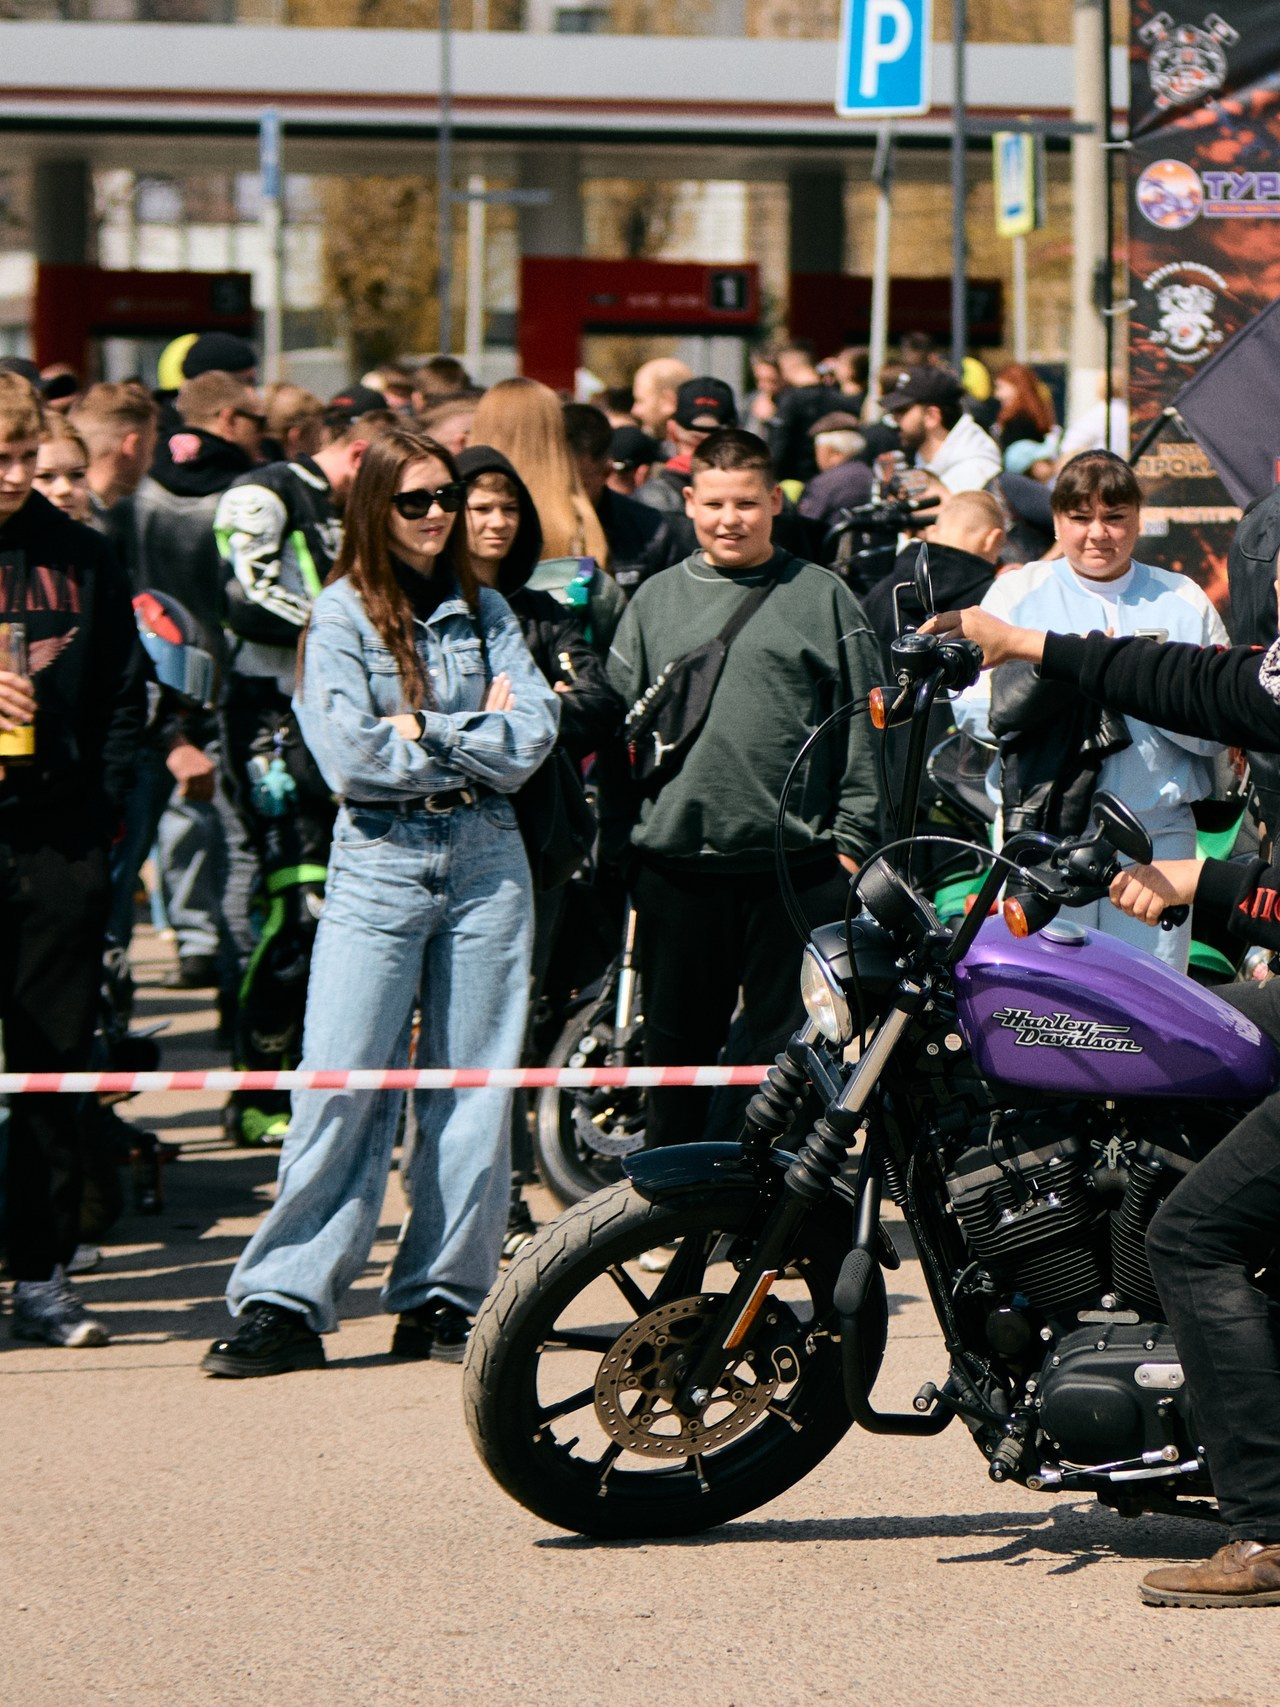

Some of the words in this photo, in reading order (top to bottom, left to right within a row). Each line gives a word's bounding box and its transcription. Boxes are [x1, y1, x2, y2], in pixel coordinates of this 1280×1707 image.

[859, 0, 913, 98] P
[992, 1007, 1131, 1036] Harley
[1015, 1027, 1143, 1053] Davidson
